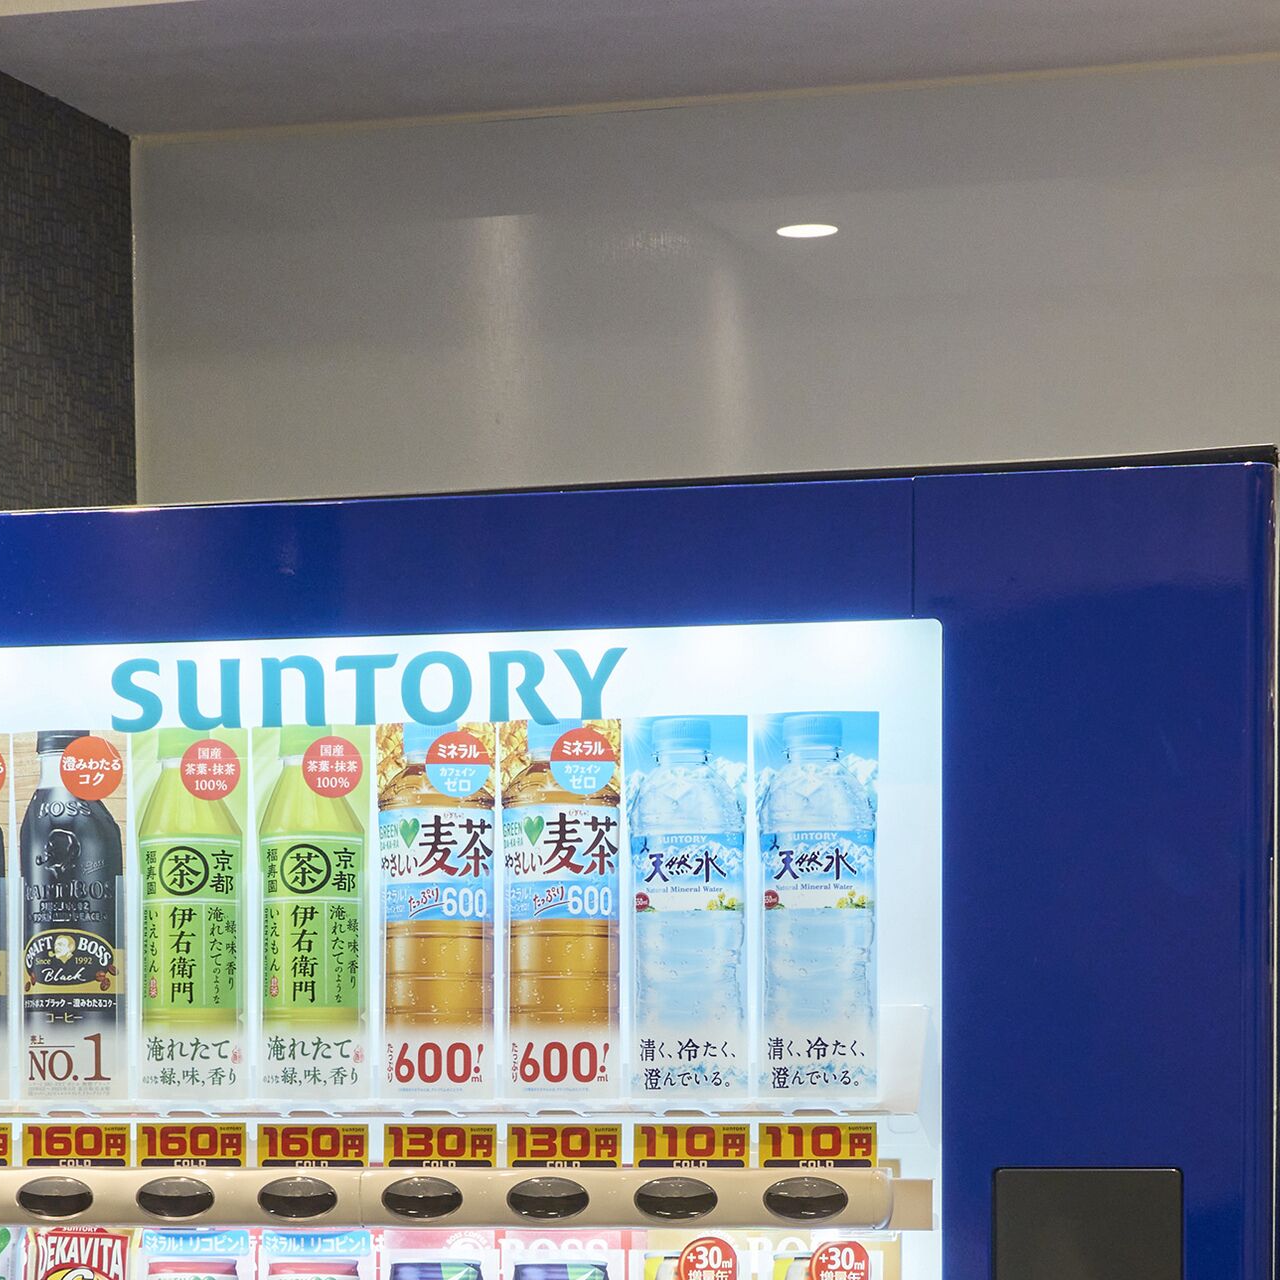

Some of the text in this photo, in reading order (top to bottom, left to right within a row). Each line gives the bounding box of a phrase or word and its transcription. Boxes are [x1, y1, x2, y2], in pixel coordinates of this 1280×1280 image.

[197, 746, 222, 760] 国産
[437, 743, 480, 760] ミネラル
[562, 740, 605, 757] ミネラル
[62, 757, 121, 774] 澄みわたる
[439, 767, 477, 778] カフェイン
[194, 778, 228, 793] 100%
[444, 778, 472, 793] ゼロ
[419, 815, 493, 877] 麦茶
[544, 813, 618, 877] 麦茶
[210, 850, 234, 894] 京都
[382, 851, 418, 877] やさしい
[644, 851, 727, 884] 天然水
[408, 886, 441, 911] たっぷり
[441, 887, 487, 917] 600
[670, 886, 701, 894] Mineral
[703, 885, 723, 893] Water
[25, 936, 111, 968] CRAFT BOSS
[169, 906, 197, 1004] 伊右衛門
[291, 904, 319, 1002] 伊右衛門
[147, 1037, 230, 1061] 淹れたて
[644, 1067, 733, 1090] 澄んでいる。
[388, 1127, 492, 1158] 130円
[641, 1127, 745, 1158] 110円
[36, 1237, 122, 1279] DEKAVITA
